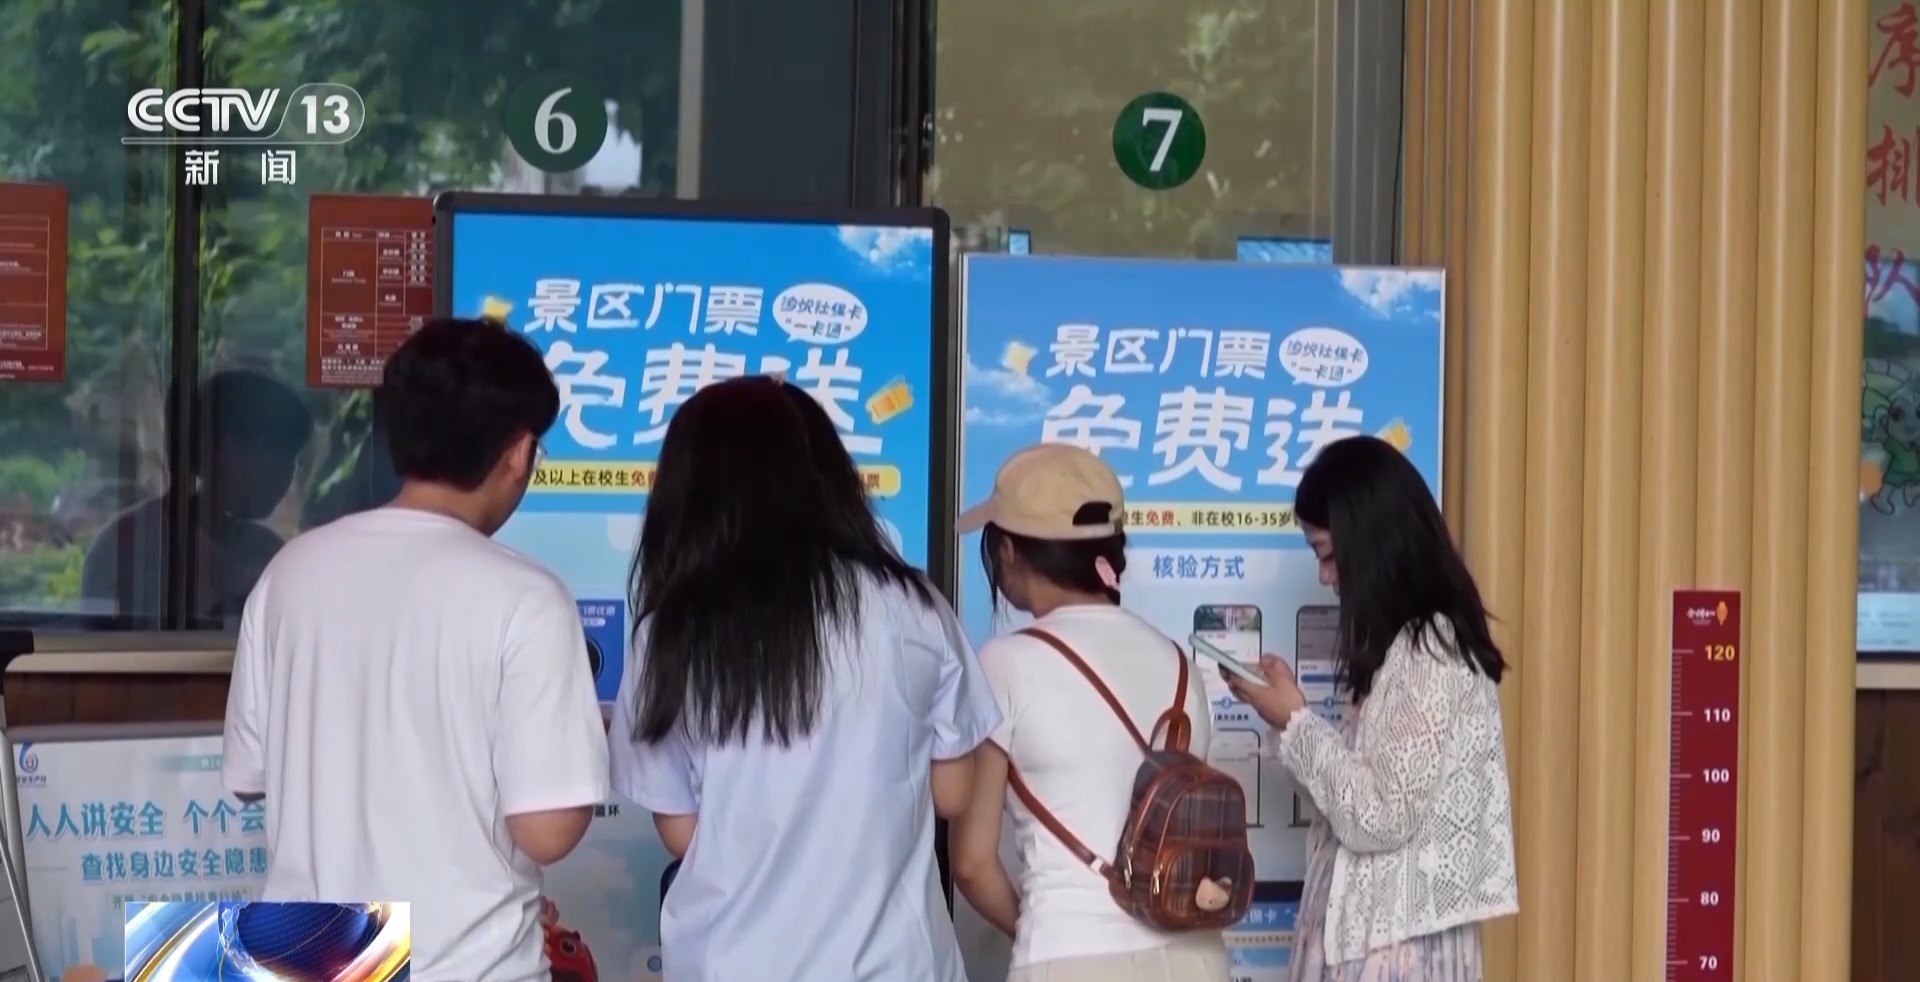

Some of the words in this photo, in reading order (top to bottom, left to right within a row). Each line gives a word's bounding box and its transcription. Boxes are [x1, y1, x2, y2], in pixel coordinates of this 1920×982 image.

[534, 88, 577, 154] 6
[1142, 108, 1183, 171] 7
[525, 278, 764, 336] 景区门票
[1046, 324, 1271, 378] 景区门票
[1122, 510, 1299, 528] 生免费、非在校16-35岁
[1153, 554, 1245, 579] 核验方式
[1704, 645, 1736, 661] 120
[1704, 708, 1731, 723] 110
[1703, 769, 1730, 783] 100
[27, 801, 164, 838] 人人讲安全
[183, 799, 265, 834] 个个会
[1702, 829, 1721, 844] 90
[81, 846, 267, 881] 查找身边安全隐患
[1700, 891, 1719, 906] 80
[1699, 955, 1718, 970] 70
